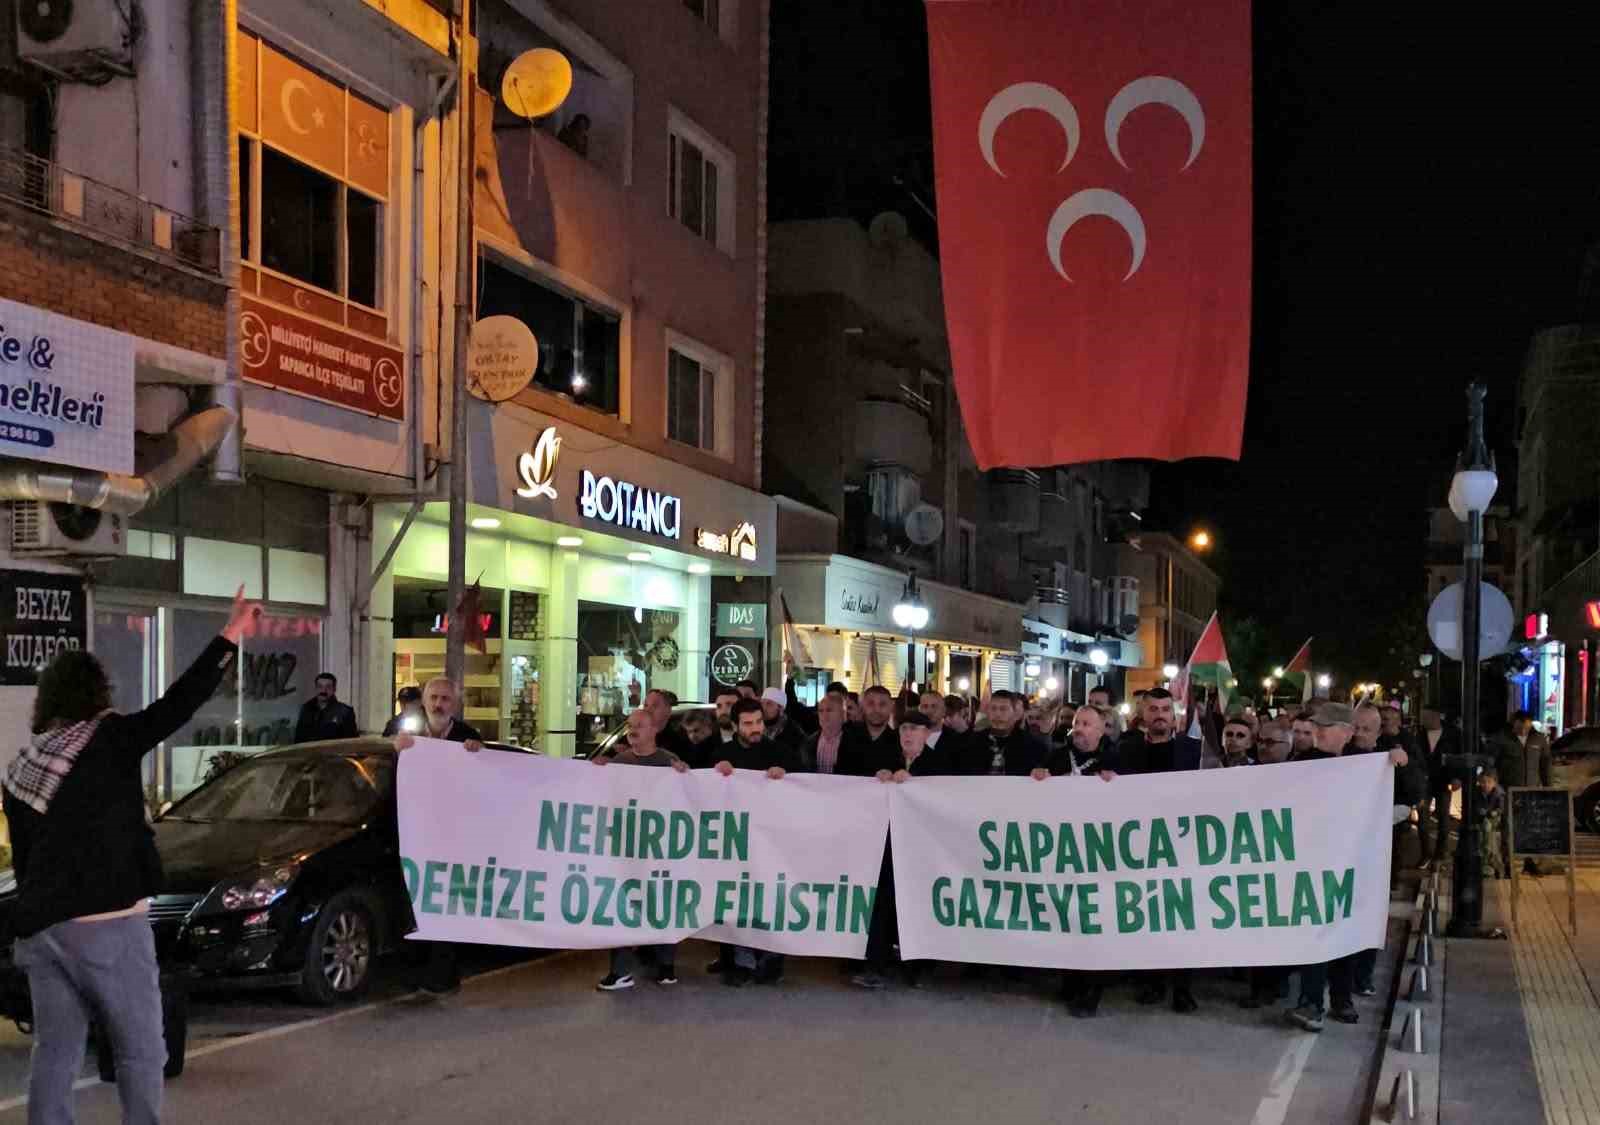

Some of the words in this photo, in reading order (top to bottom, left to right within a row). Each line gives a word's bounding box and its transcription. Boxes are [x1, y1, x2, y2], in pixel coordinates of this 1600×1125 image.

[29, 336, 54, 369] &
[279, 354, 315, 379] SAPANCA
[16, 587, 72, 621] BEYAZ
[537, 799, 750, 862] NEHİRDEN
[400, 856, 547, 923] DENİZE
[560, 864, 703, 930] ÖZGÜR
[713, 871, 878, 935] FİLİSTİN
[931, 876, 1104, 935] GAZZEYE
[1114, 877, 1196, 934] BİN
[1208, 867, 1355, 929] SELAM
